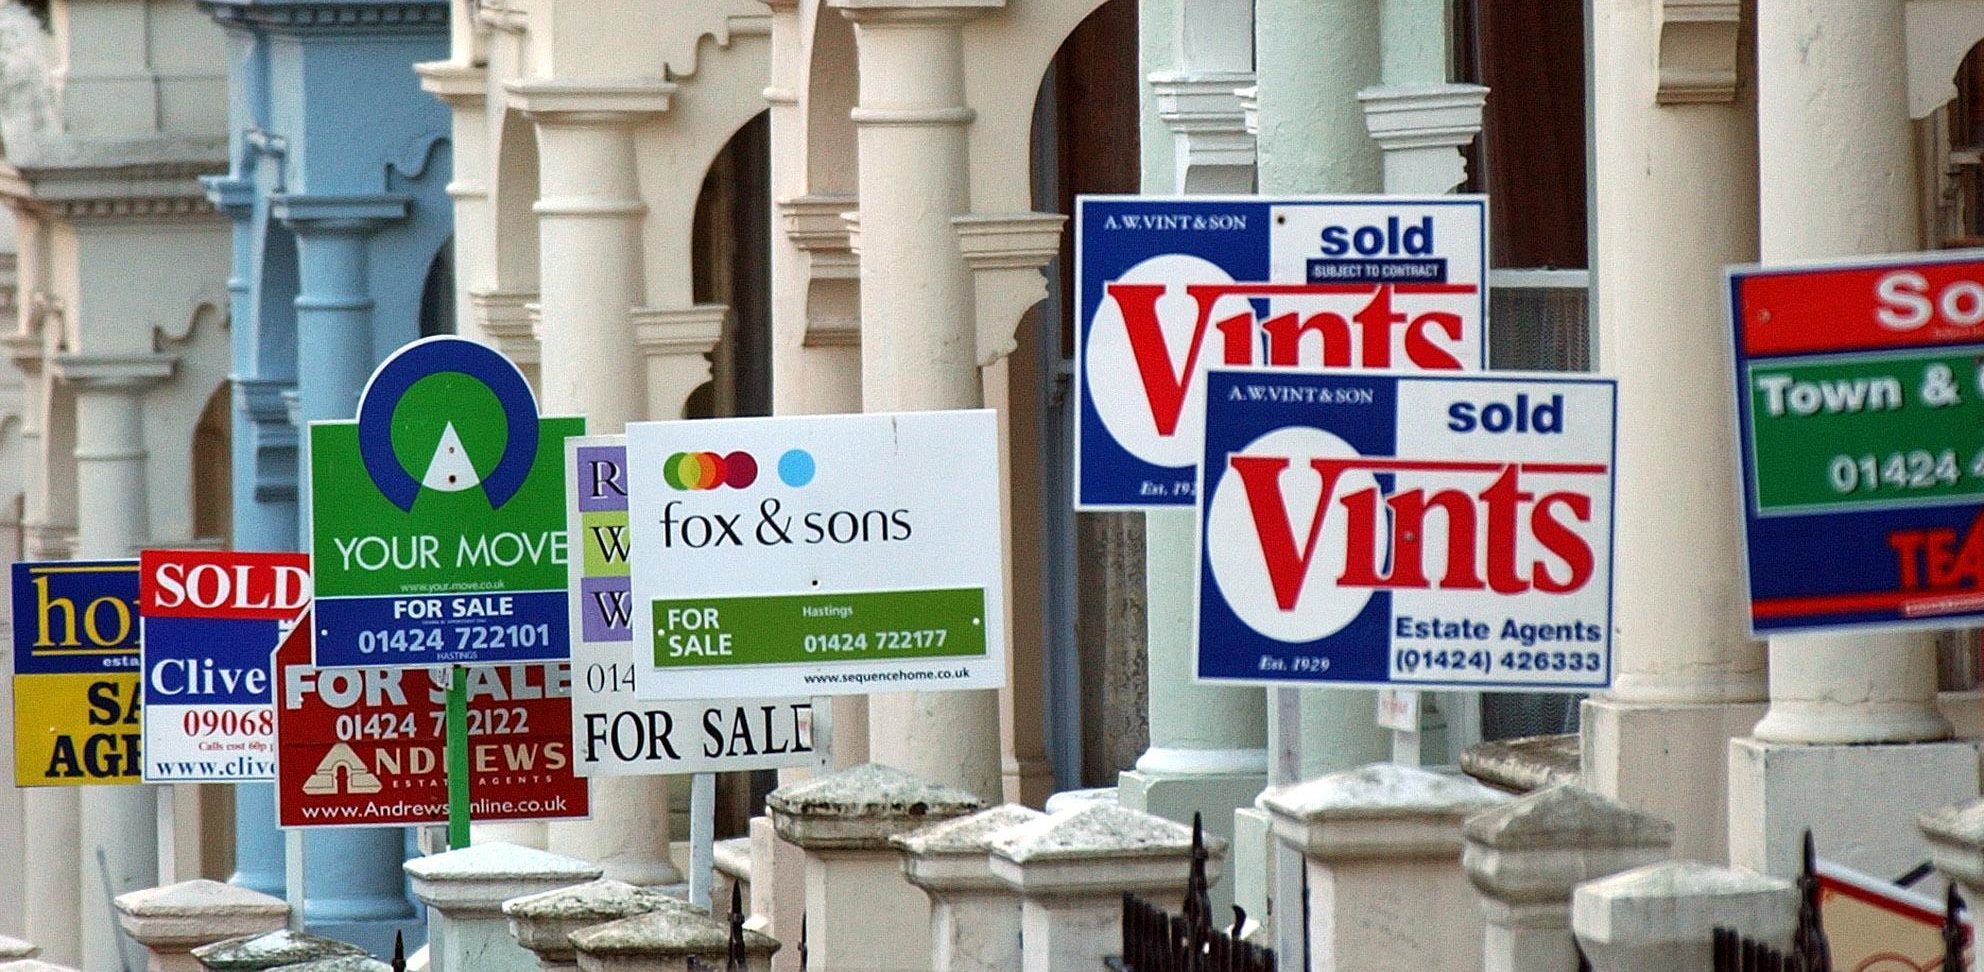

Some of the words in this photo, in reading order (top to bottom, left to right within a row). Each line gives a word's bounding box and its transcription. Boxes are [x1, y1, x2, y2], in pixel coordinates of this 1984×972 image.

[1320, 216, 1434, 255] sold
[1313, 263, 1362, 279] SUBJECT
[1365, 263, 1380, 277] TO
[1382, 263, 1440, 278] CONTRACT
[1875, 270, 1984, 331] So
[1107, 284, 1477, 436] Vints
[1757, 374, 1903, 418] Town
[1921, 363, 1962, 406] &
[1448, 394, 1564, 433] sold
[1830, 449, 1962, 494] 01424
[659, 500, 743, 548] fox
[755, 497, 793, 546] &
[804, 509, 912, 543] sons
[1230, 457, 1608, 612] Vints
[334, 535, 440, 571] YOUR
[456, 531, 568, 568] MOVE
[155, 563, 310, 608] SOLD
[32, 576, 140, 647] ho
[394, 599, 443, 619] FOR
[452, 597, 513, 617] SALE
[668, 608, 719, 630] FOR
[802, 605, 853, 619] Hastings
[358, 628, 444, 654] 01424
[455, 624, 549, 651] 722101
[668, 635, 732, 657] SALE
[804, 633, 867, 652] 01424
[876, 629, 947, 650] 722177
[1396, 617, 1490, 640] Estate
[1501, 619, 1601, 646] Agents
[437, 651, 478, 660] HASTINGS
[1293, 655, 1330, 673] 1929
[1397, 649, 1492, 673] (01424)
[1501, 650, 1600, 672] 426333
[151, 658, 267, 695] Clive
[285, 664, 407, 710] FOR
[804, 667, 970, 684] www.sequencehome.co.uk
[184, 709, 273, 736] 09068
[335, 712, 417, 741] 01424
[430, 707, 530, 739] 72122
[583, 710, 680, 762] FOR
[199, 742, 223, 751] Calls
[226, 743, 245, 751] cost
[479, 775, 551, 786] AGENTS
[302, 795, 567, 818] www.Andrewsnline.co.uk
